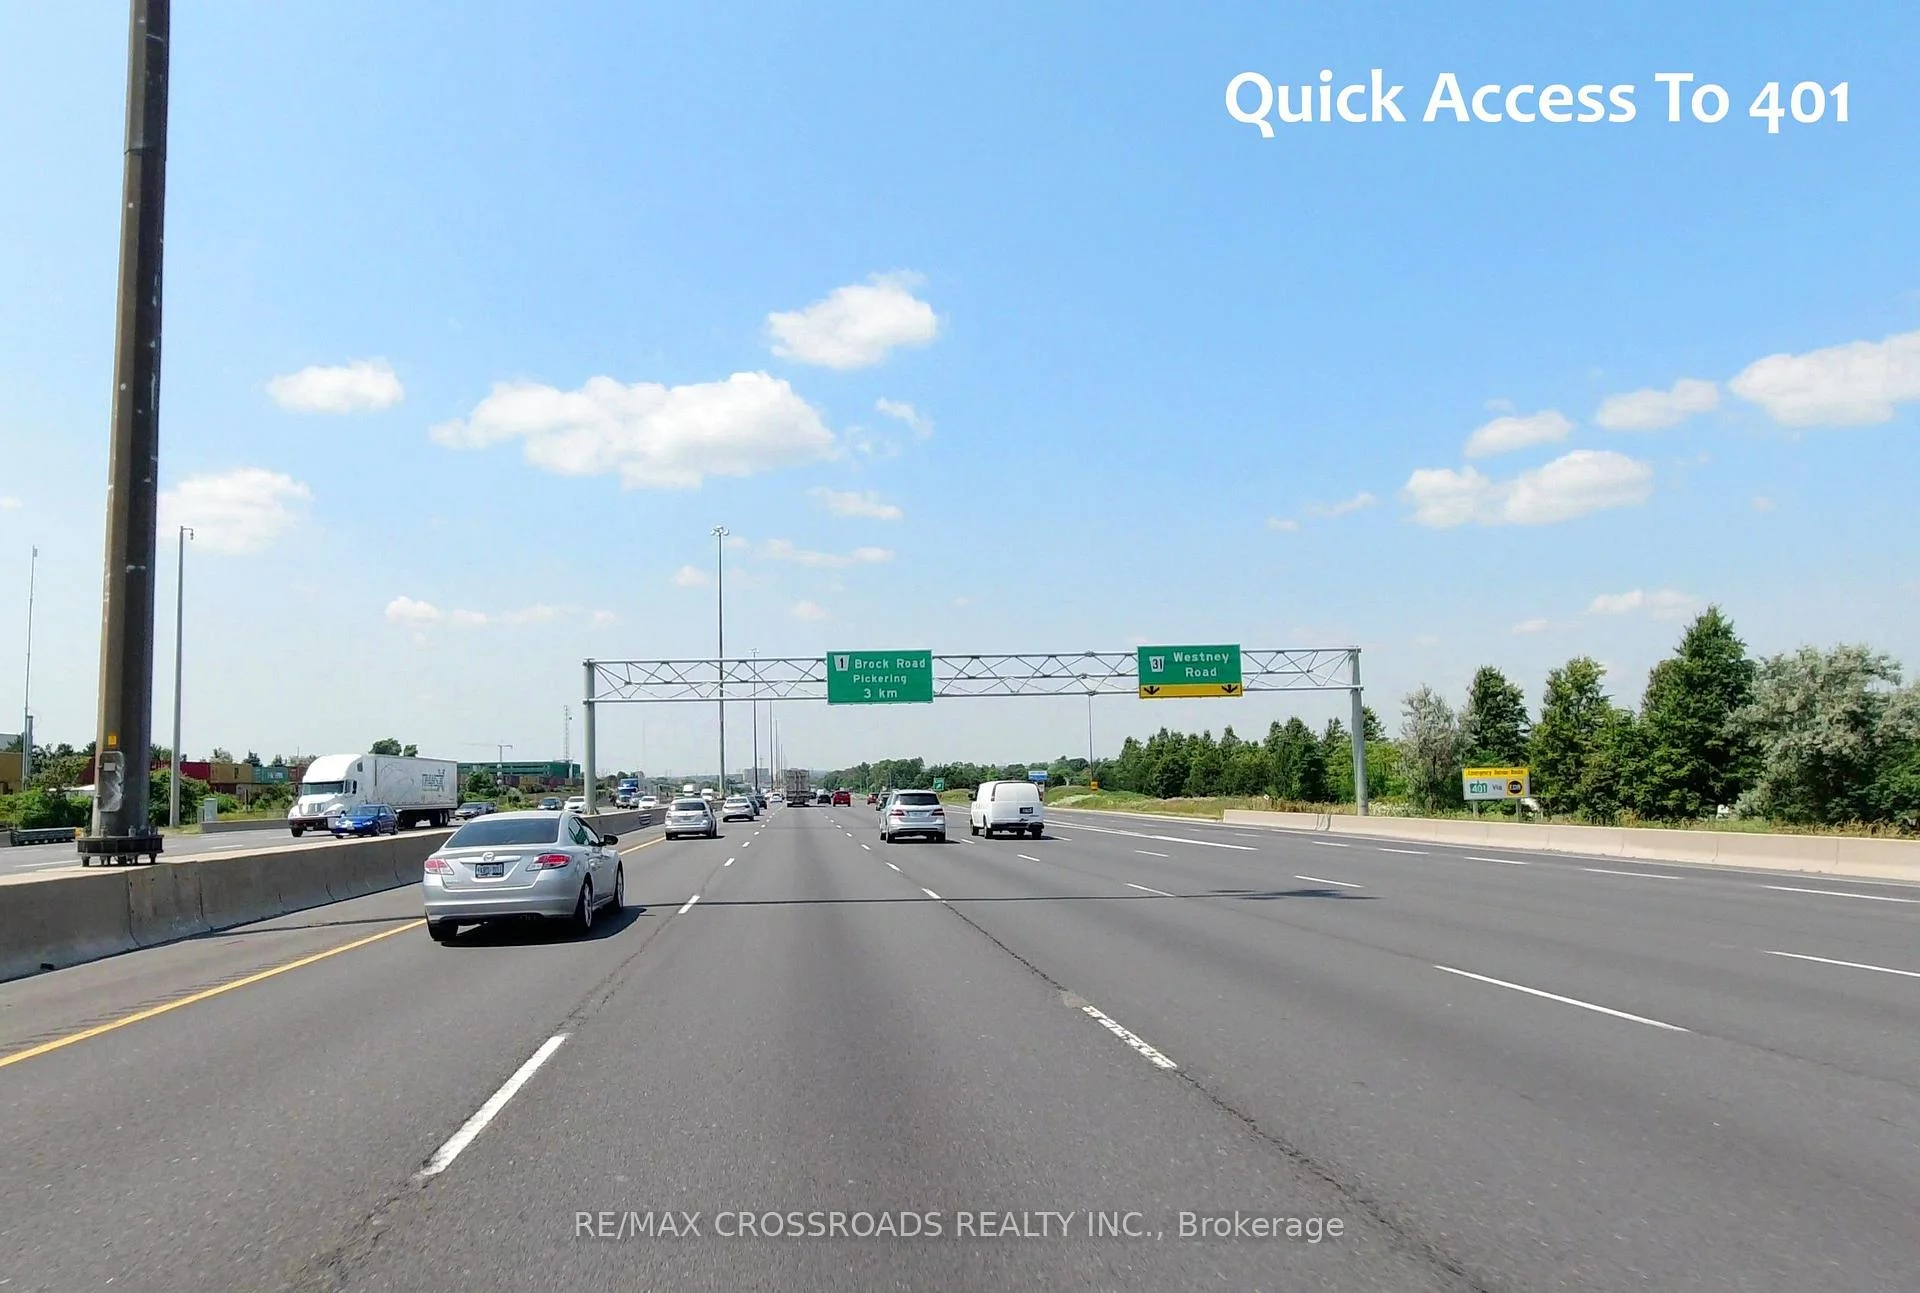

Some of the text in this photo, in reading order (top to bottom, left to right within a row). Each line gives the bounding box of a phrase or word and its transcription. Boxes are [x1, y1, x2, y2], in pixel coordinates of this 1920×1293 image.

[1173, 651, 1229, 664] Westney
[854, 659, 889, 669] Brock
[896, 658, 926, 669] Road
[1152, 658, 1163, 670] 31
[1185, 667, 1217, 677] Road
[853, 674, 907, 685] Pickering
[863, 688, 898, 698] 3 km
